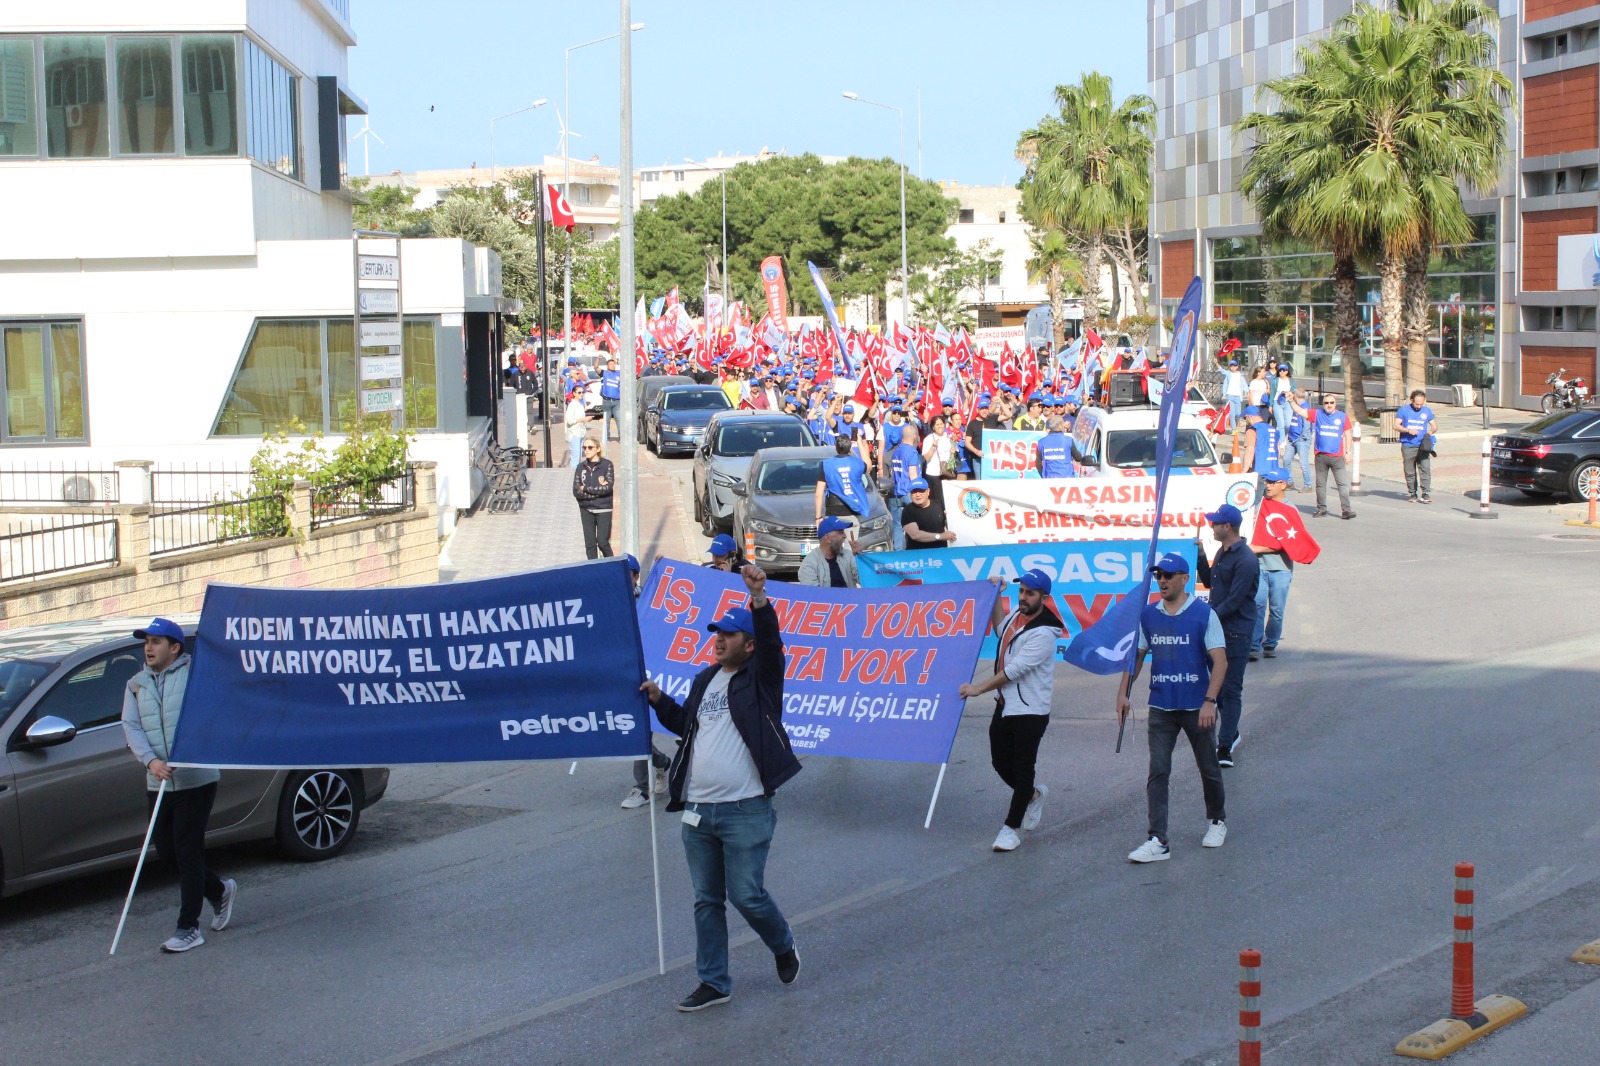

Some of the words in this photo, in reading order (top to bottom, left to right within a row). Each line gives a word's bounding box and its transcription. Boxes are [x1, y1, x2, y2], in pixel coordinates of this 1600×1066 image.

[1049, 485, 1157, 509] YAŞASIN
[651, 567, 701, 625] İŞ,
[862, 598, 975, 638] YOKSA
[225, 617, 294, 641] KIDEM
[300, 609, 432, 641] TAZMİNATI
[440, 598, 595, 637] HAKKIMIZ,
[241, 648, 401, 678] UYARIYORUZ,
[409, 647, 441, 672] EL
[448, 636, 575, 672] UZATANI
[838, 650, 911, 684] YOK
[338, 680, 466, 706] YAKARIZ!
[848, 691, 940, 722] İŞÇİLERİ
[501, 711, 636, 741] petrol-iş
